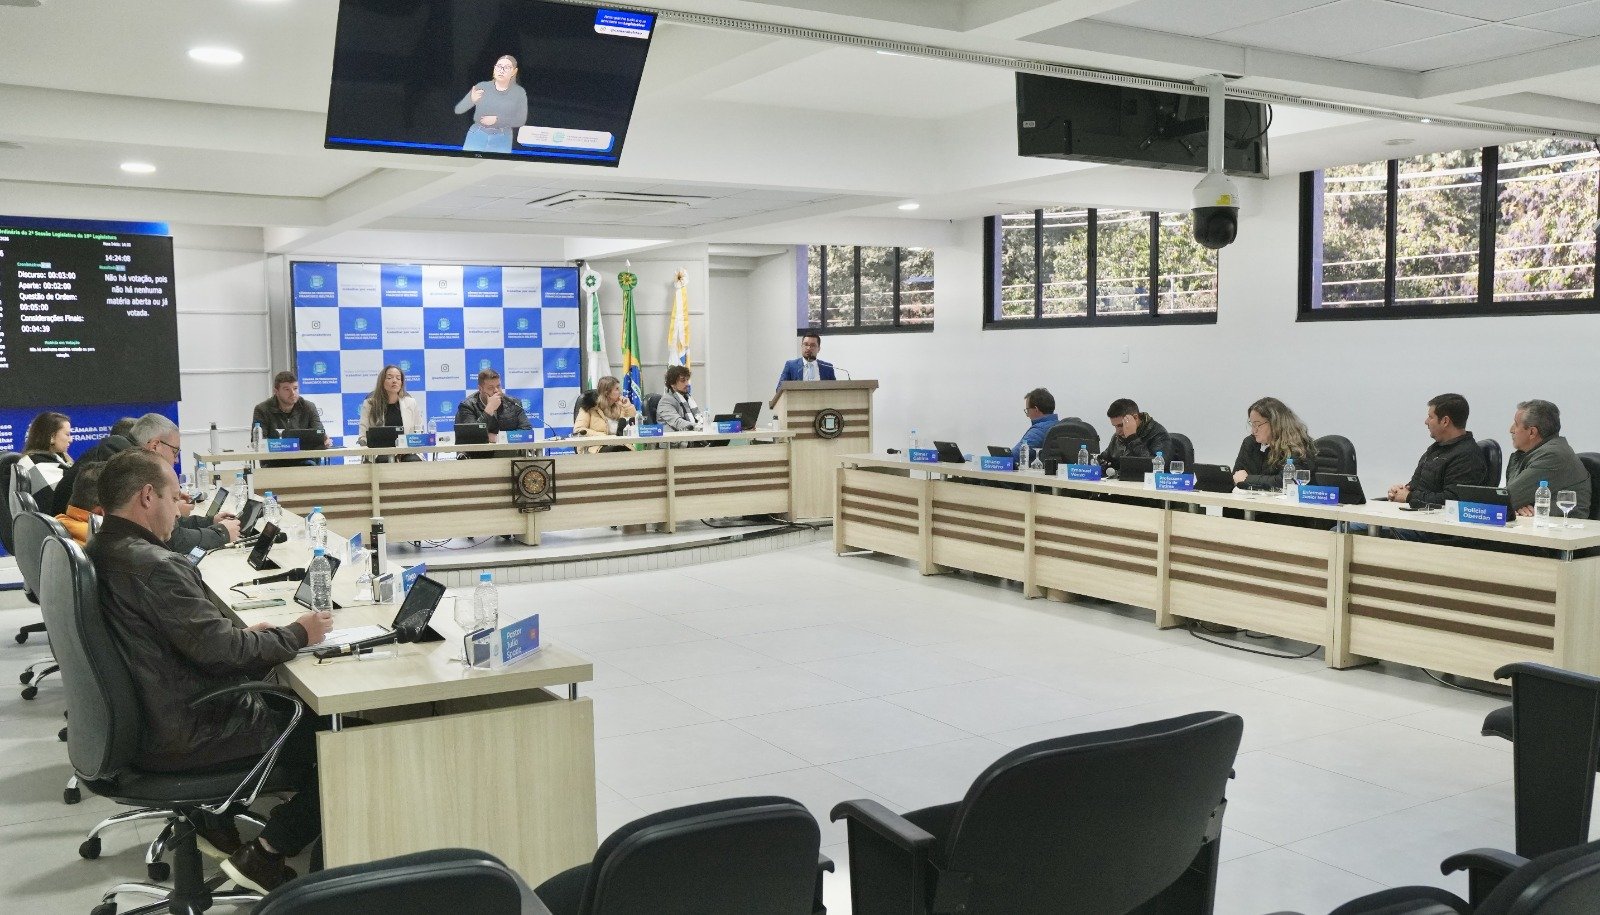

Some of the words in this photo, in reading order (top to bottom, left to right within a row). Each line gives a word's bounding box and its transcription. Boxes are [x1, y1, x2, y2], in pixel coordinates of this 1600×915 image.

[18, 270, 46, 278] Discurso:
[118, 274, 127, 282] há
[128, 275, 154, 283] votação,
[155, 276, 168, 284] pois
[18, 282, 41, 290] Aparte:
[134, 286, 162, 294] nenhuma
[19, 292, 45, 301] Questão
[162, 298, 168, 307] já
[21, 314, 64, 322] Considerações
[1463, 512, 1491, 520] Oberdan
[506, 628, 522, 639] Pastor
